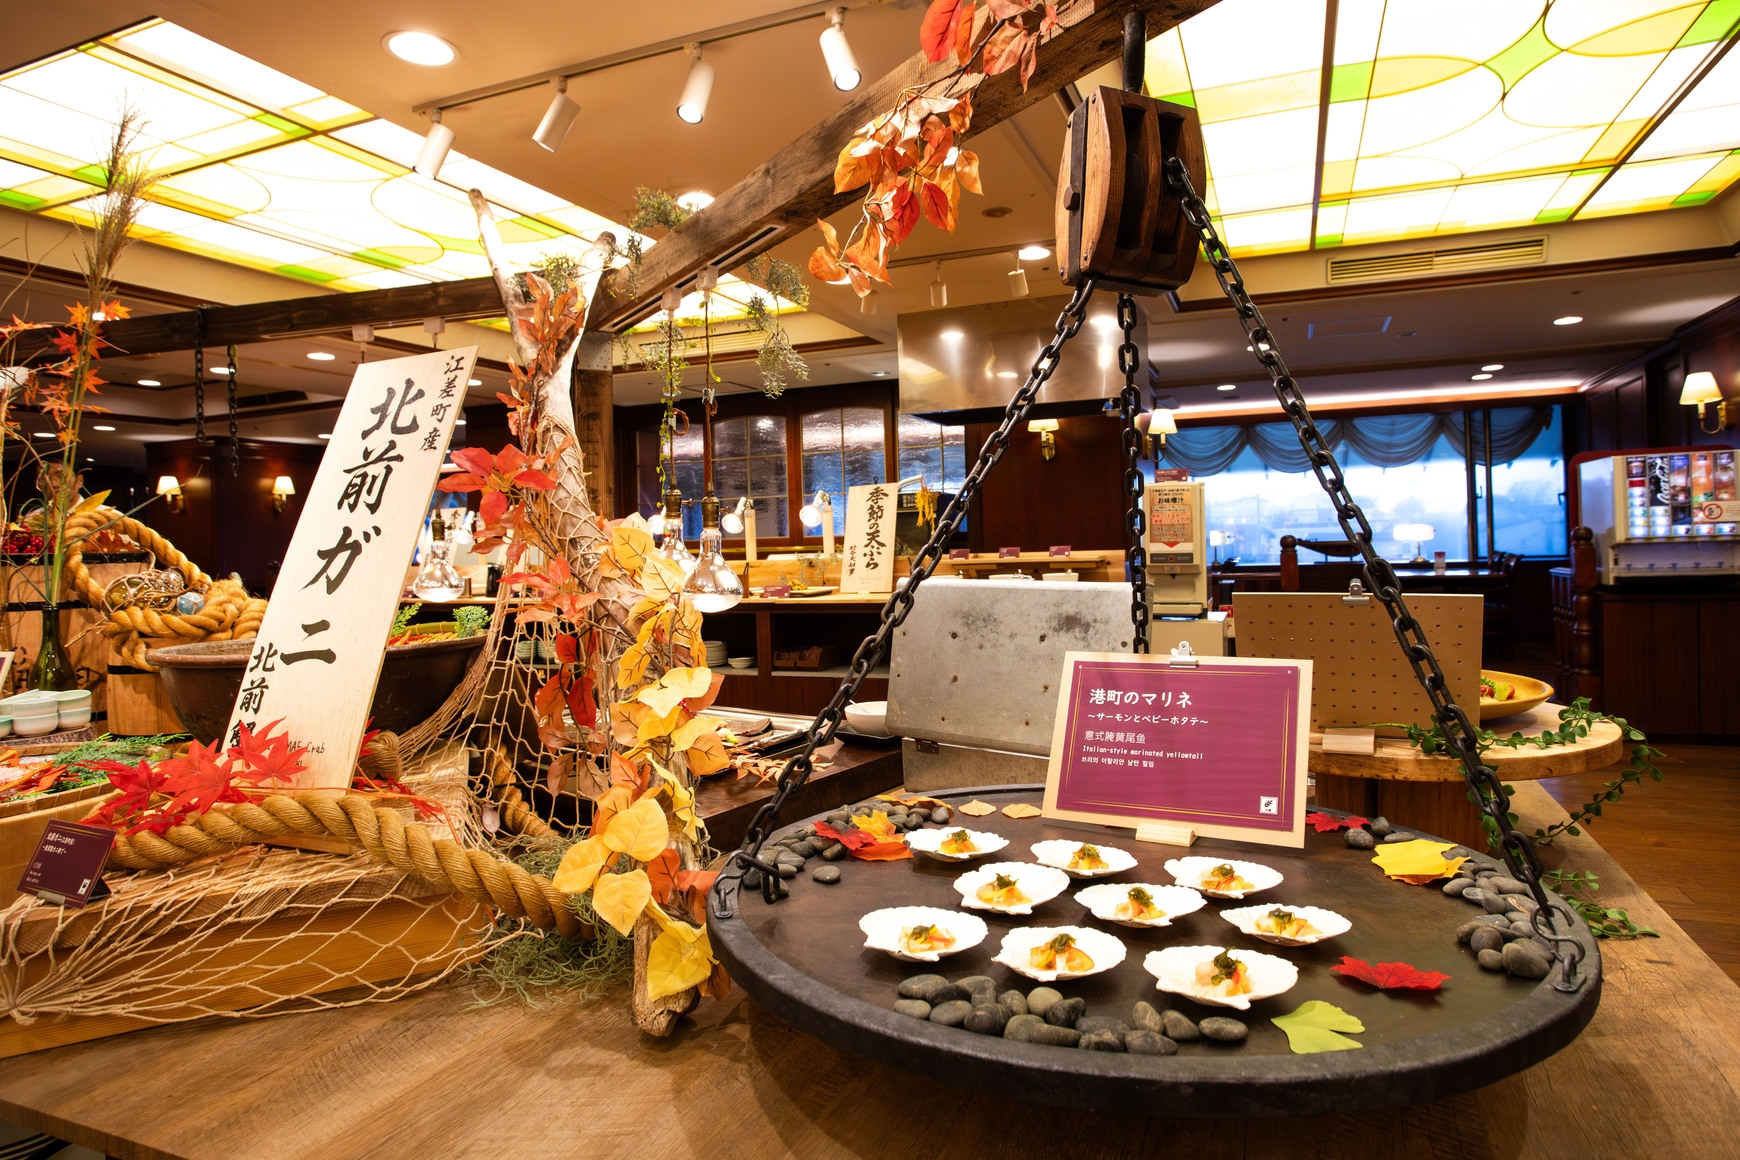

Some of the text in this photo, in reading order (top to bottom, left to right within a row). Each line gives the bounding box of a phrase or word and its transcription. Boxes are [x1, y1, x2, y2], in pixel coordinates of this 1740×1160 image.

[418, 354, 465, 454] 江差町産
[279, 377, 426, 665] 北前ガニ
[863, 486, 889, 571] 季節の天ぷら
[1089, 688, 1192, 708] 港町のマリネ
[1082, 745, 1203, 760] Italian-style marinated yellowtail
